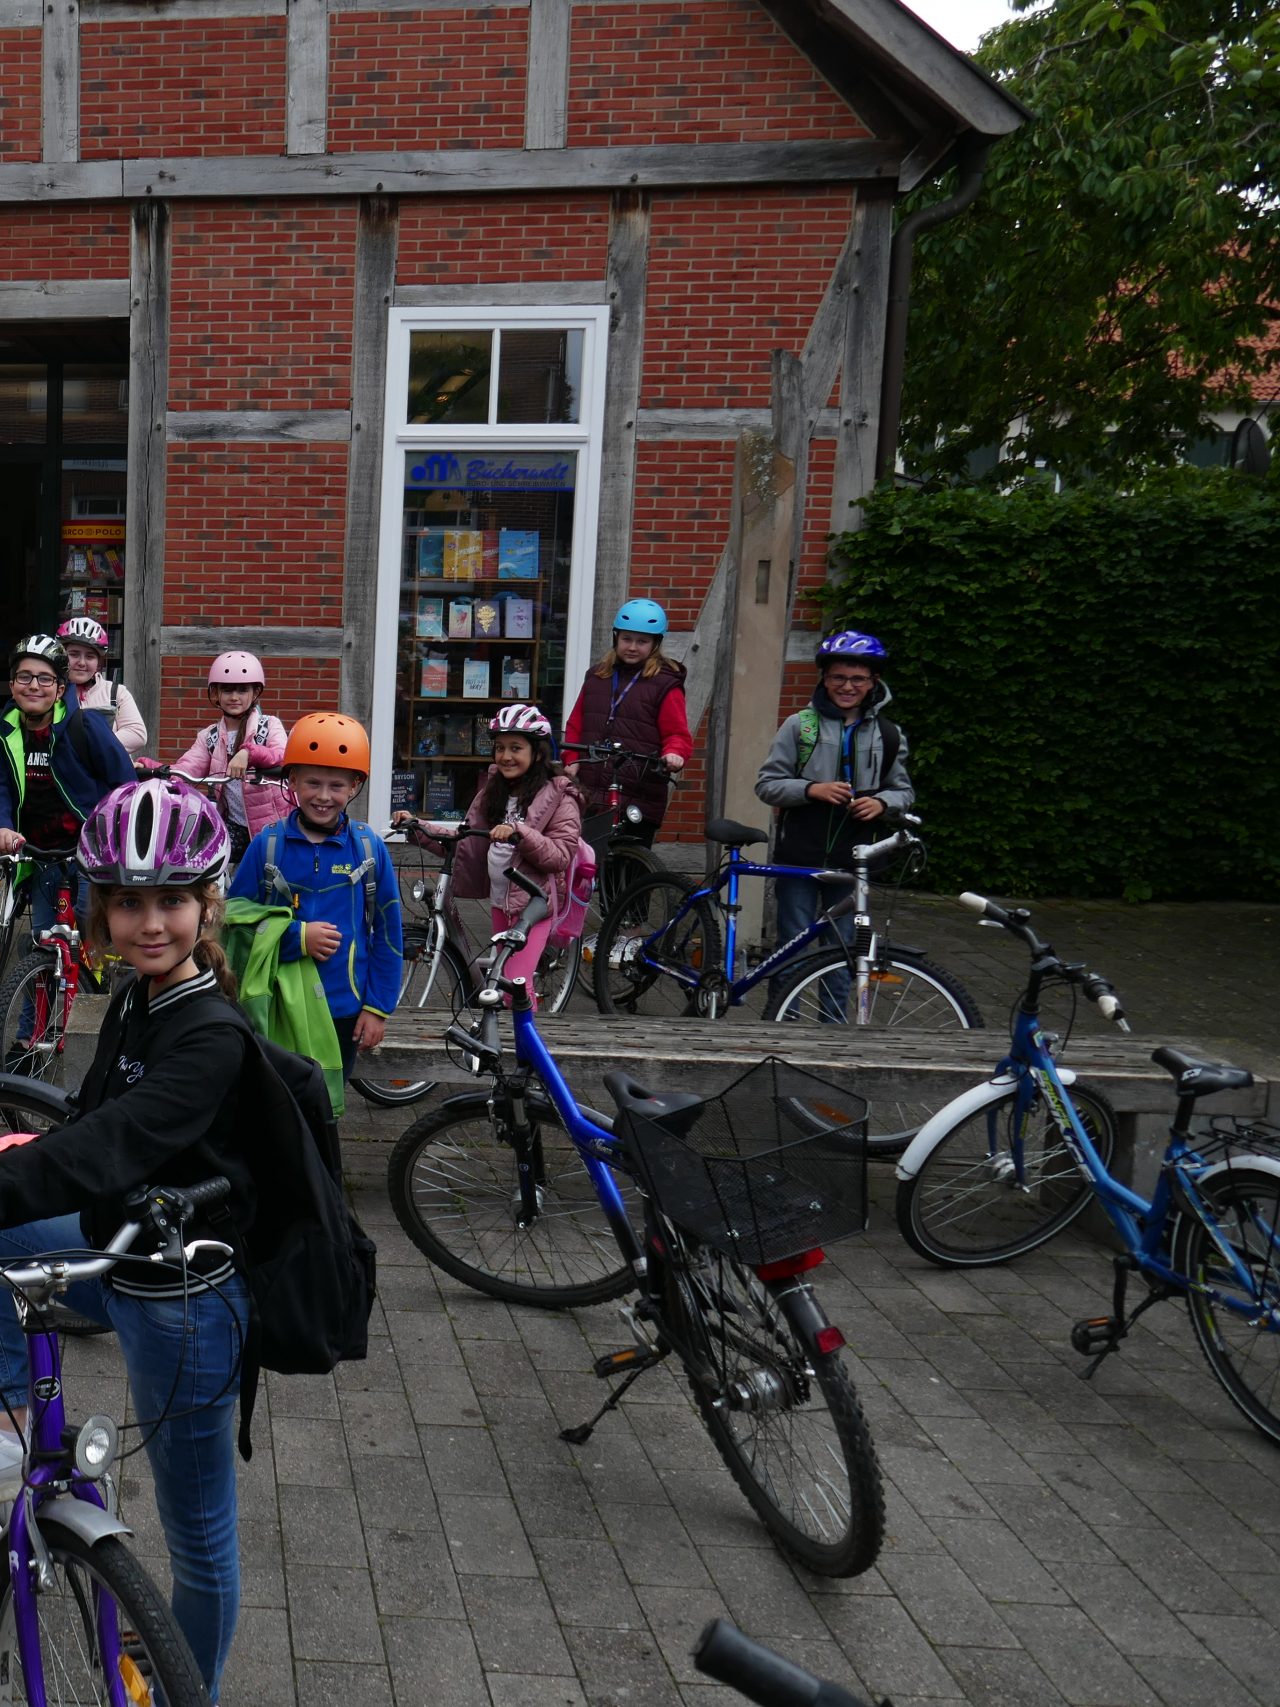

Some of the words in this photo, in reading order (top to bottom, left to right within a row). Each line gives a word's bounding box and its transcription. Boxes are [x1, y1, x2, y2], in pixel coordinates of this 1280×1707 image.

[466, 459, 569, 480] Bücherwelt
[62, 528, 84, 536] ARCO
[95, 528, 122, 536] POLO
[745, 927, 811, 980] SCHWINN
